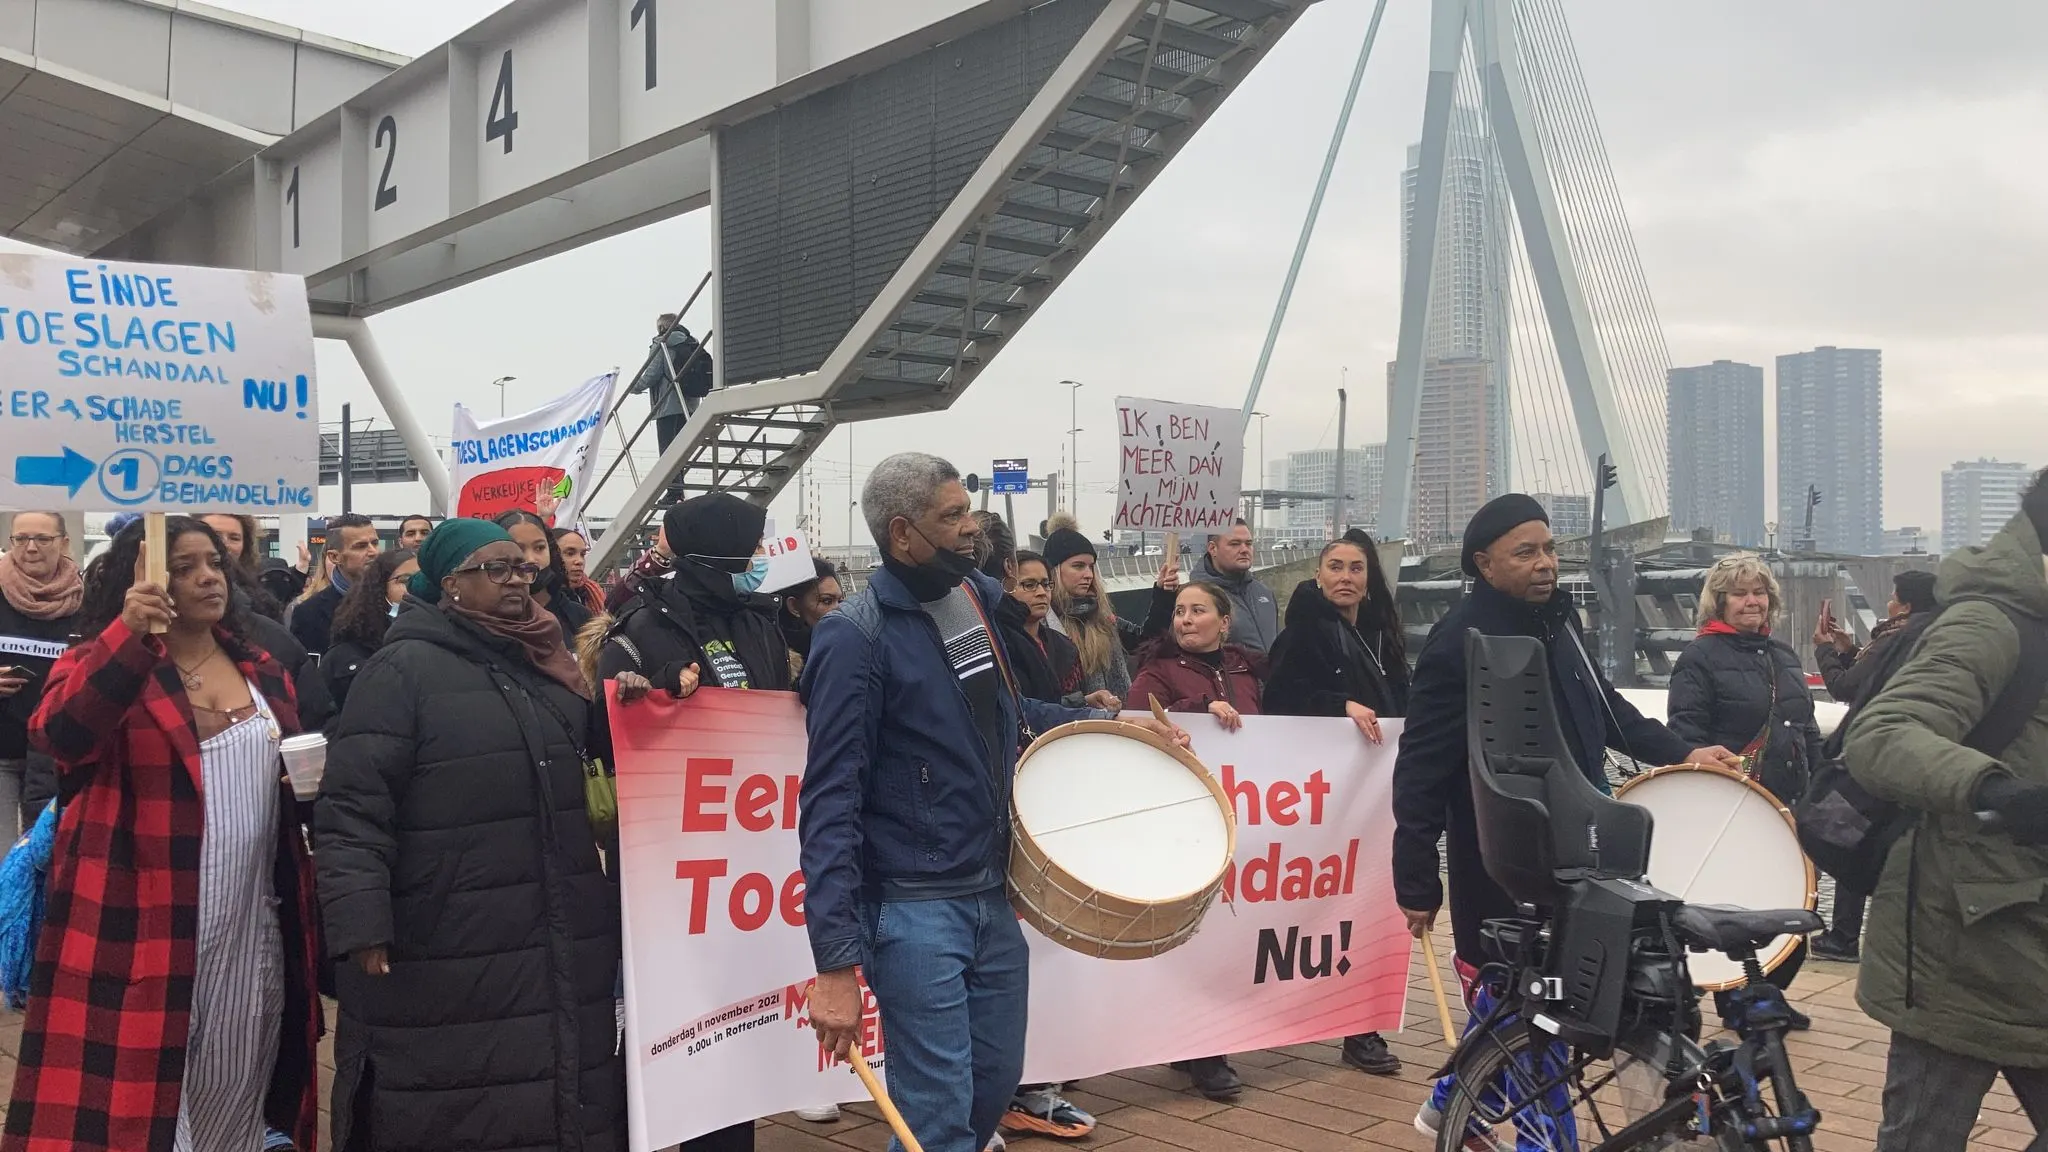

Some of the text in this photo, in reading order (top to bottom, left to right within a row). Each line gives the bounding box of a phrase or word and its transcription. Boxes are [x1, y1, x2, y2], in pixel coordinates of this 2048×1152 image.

[287, 0, 657, 249] 1 2 4 1
[57, 350, 229, 385] SCHANDAAL
[85, 395, 183, 421] SCHADE
[1119, 408, 1149, 437] IK
[1170, 414, 1209, 441] BEN
[115, 422, 216, 445] HERSTEL
[163, 455, 233, 478] DAGS
[1123, 445, 1223, 477] MEER DAN
[1221, 765, 1331, 826] het
[1253, 920, 1353, 985] Nu!
[651, 1026, 695, 1055] donderdag
[705, 1003, 754, 1029] november
[758, 993, 779, 1010] 2021
[687, 1037, 712, 1056] 9.00u
[714, 1032, 723, 1043] in
[726, 1013, 779, 1038] Rotterdam
